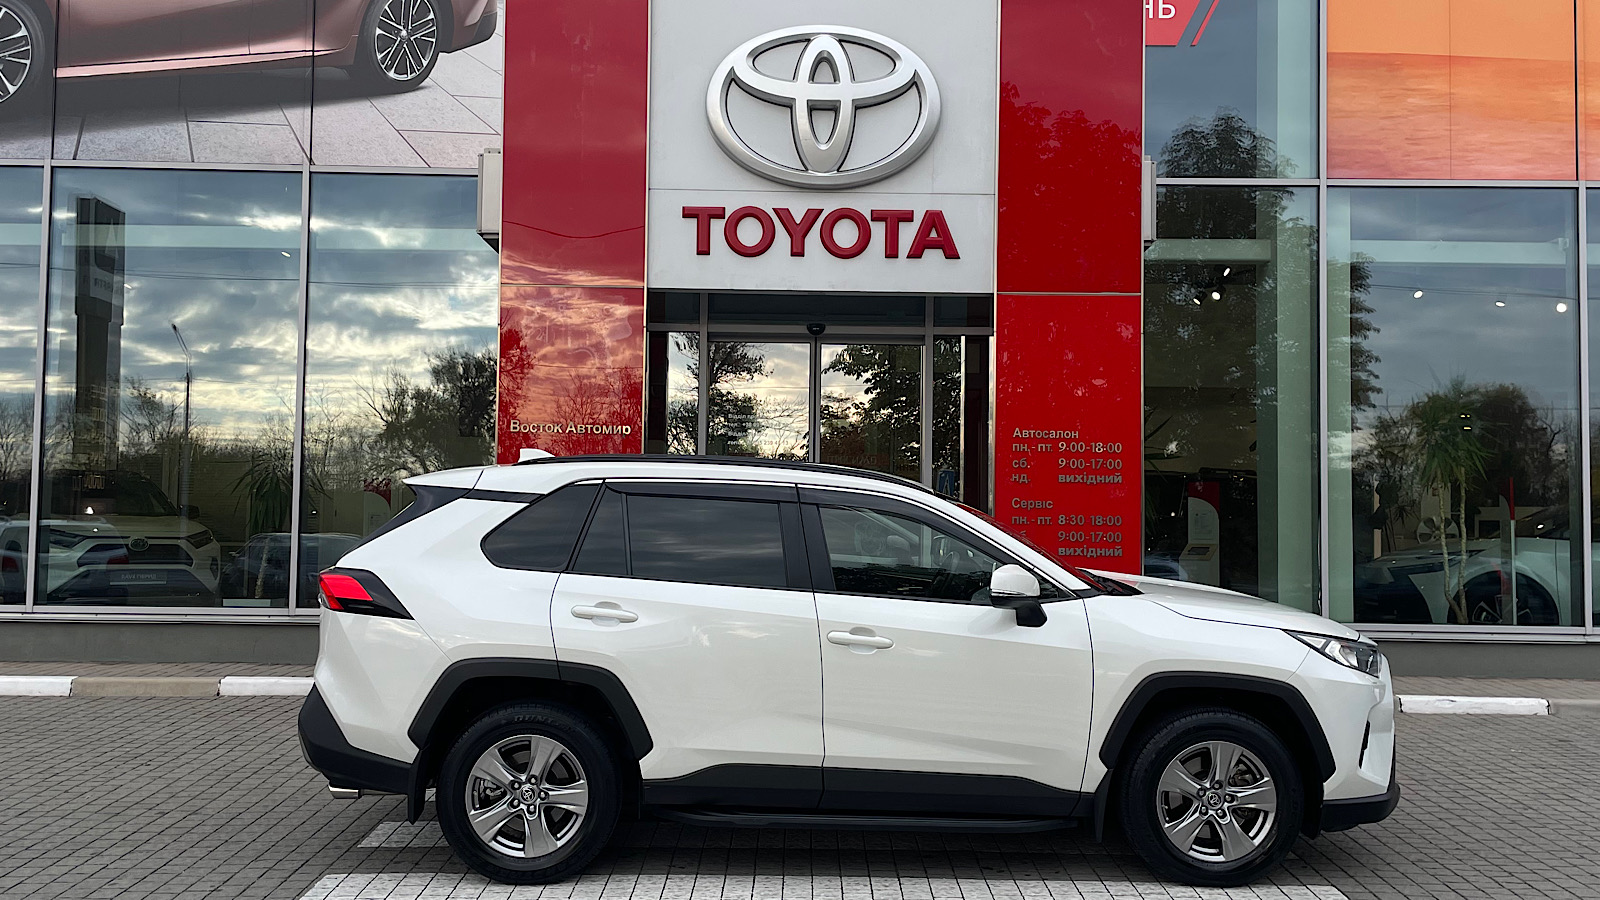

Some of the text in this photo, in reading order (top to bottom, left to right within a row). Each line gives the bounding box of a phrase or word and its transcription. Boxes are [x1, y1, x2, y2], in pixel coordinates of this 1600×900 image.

[682, 205, 961, 260] TOYOTA
[510, 419, 631, 438] Восток Автомир
[1012, 427, 1079, 439] Автосалон
[1012, 457, 1122, 470] сб. 9:00-17:00
[1012, 471, 1122, 484] нд. вихідний
[1011, 497, 1054, 511] Сервіс
[1057, 531, 1122, 543] 9:00-17:00
[1058, 544, 1122, 558] вихідний
